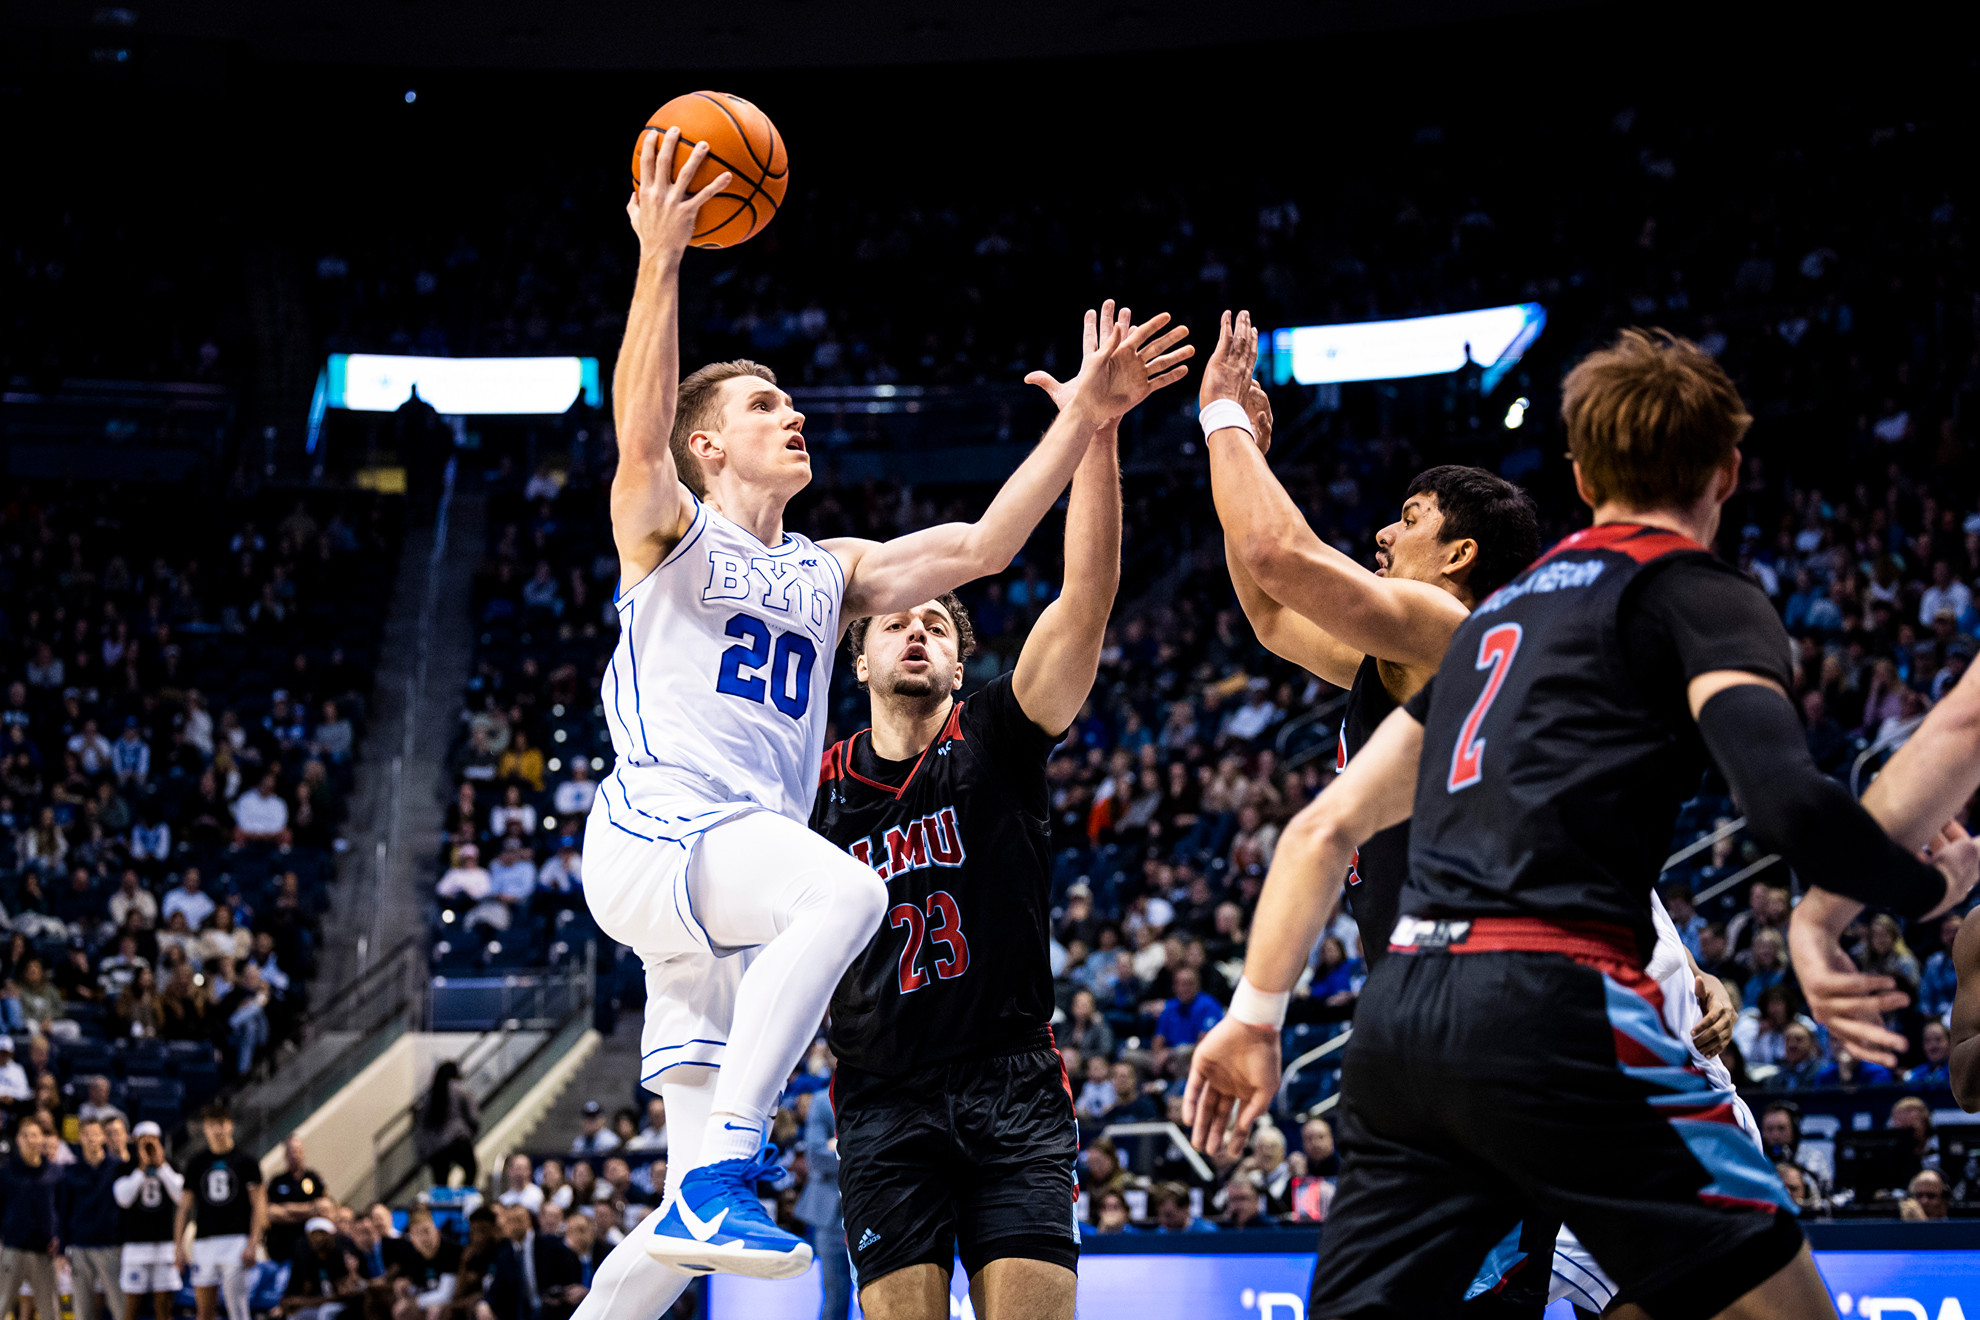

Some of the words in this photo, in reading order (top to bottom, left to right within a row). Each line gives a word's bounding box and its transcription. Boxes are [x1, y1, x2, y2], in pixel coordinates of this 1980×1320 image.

[703, 551, 832, 643] BYU
[716, 613, 817, 720] 20
[1447, 622, 1523, 793] 2
[849, 805, 966, 883] LMU
[888, 890, 970, 995] 23
[858, 1233, 882, 1252] adidas
